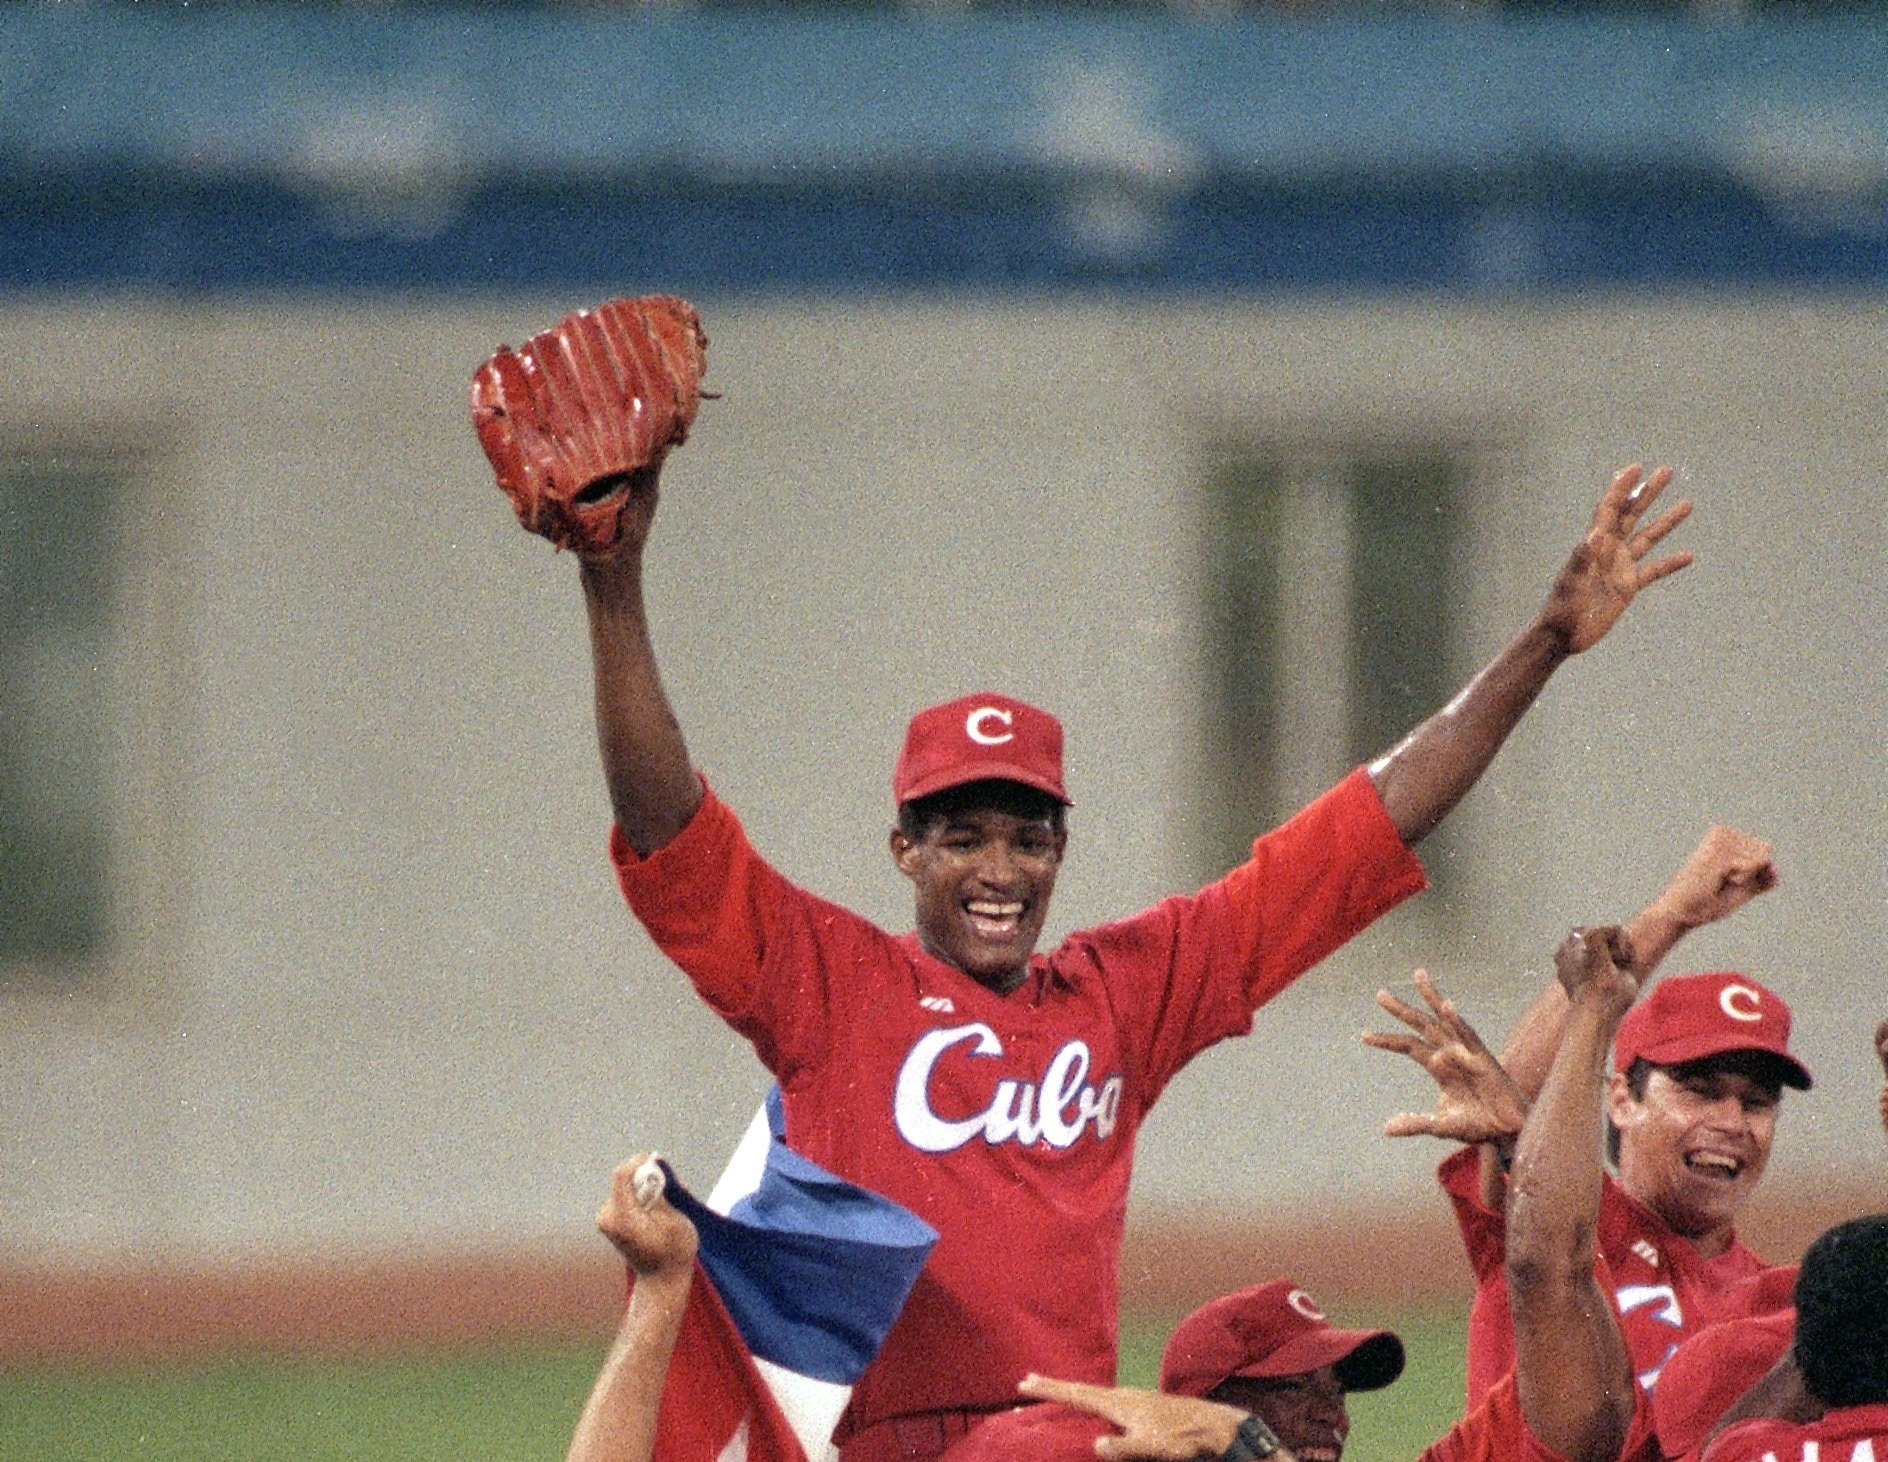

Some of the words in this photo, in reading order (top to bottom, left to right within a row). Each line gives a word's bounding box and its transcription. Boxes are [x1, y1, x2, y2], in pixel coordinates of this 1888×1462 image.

[966, 706, 1013, 746] C
[1719, 983, 1762, 1022] C
[894, 1021, 1123, 1154] Cuba
[1288, 1288, 1326, 1321] C
